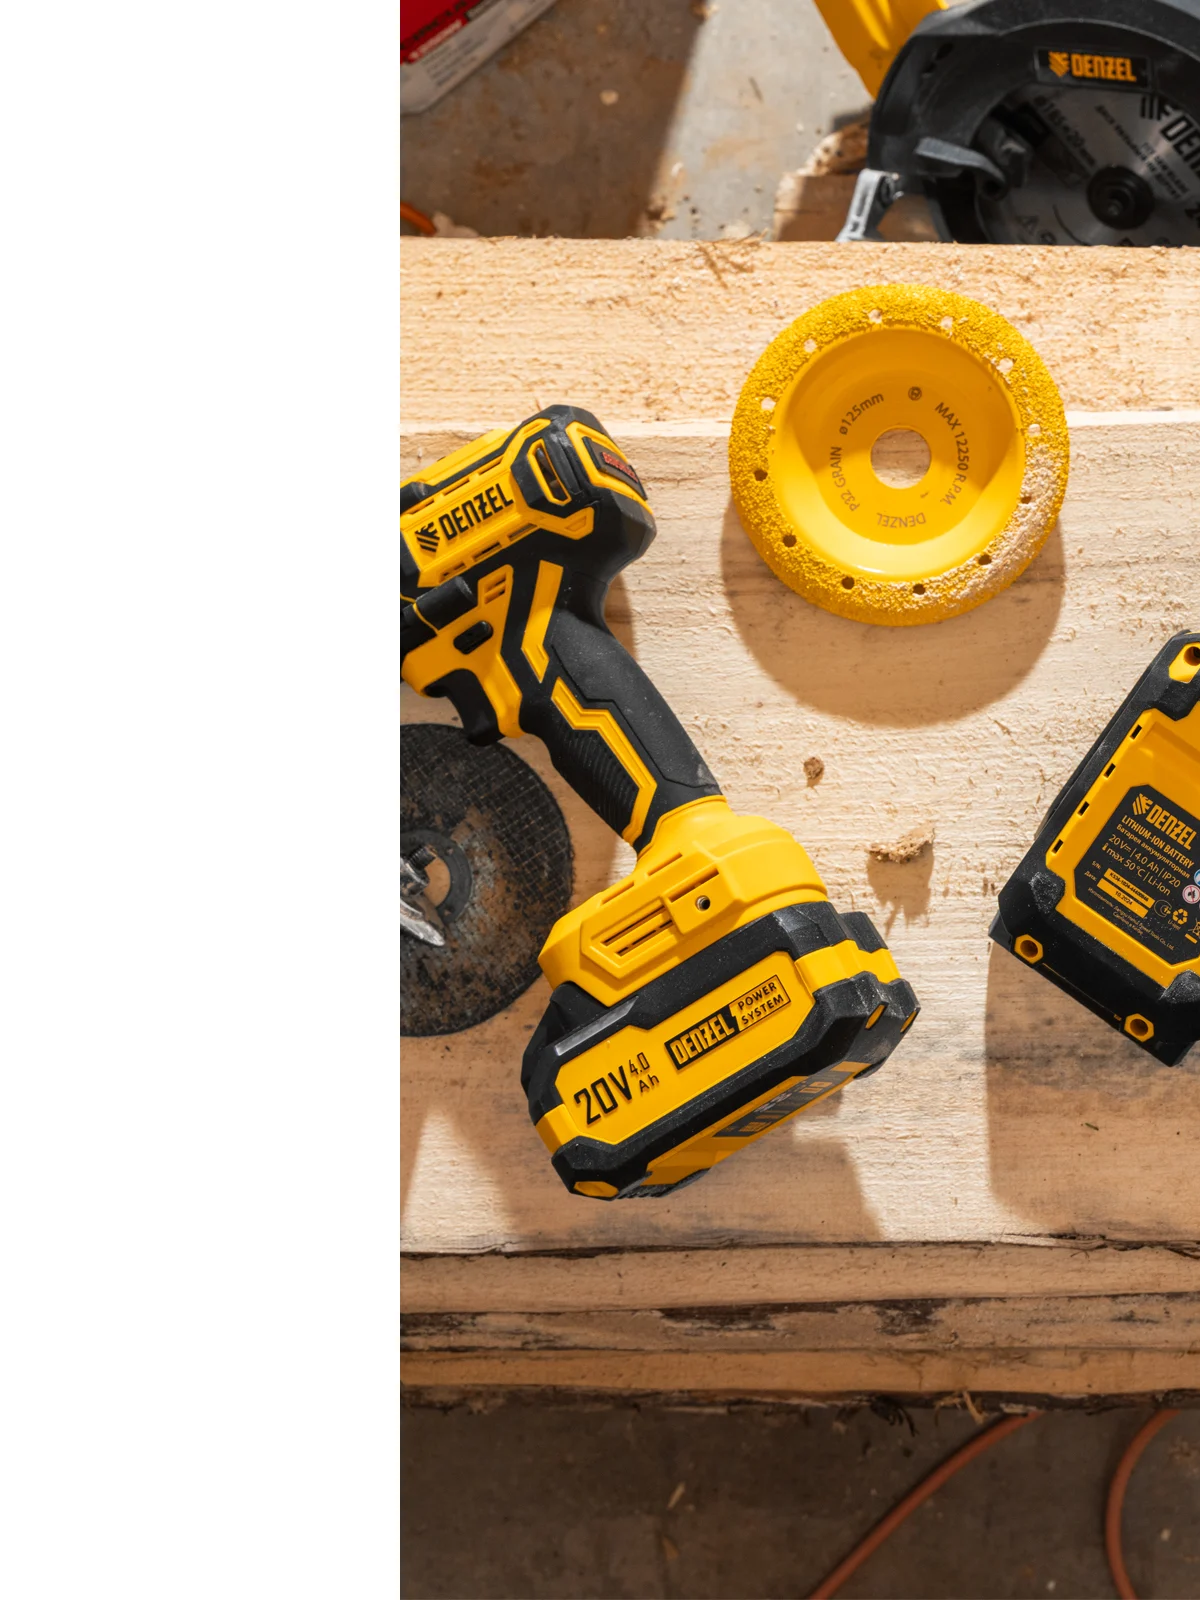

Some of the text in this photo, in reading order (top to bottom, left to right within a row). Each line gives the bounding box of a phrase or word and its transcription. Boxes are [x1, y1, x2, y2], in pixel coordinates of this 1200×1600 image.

[1071, 54, 1136, 81] DENZEL
[934, 402, 961, 430] MAX
[954, 431, 969, 471] 12250
[830, 446, 860, 511] P32 GRAIN
[439, 483, 514, 540] DENZEL
[876, 512, 926, 528] DENZEL
[1115, 823, 1142, 844] Батарея
[1121, 814, 1194, 869] LITHIUM-ION BATTERY
[1145, 803, 1200, 850] DENZEL
[1106, 846, 1125, 863] max
[1133, 851, 1148, 865] 4.0
[1146, 860, 1160, 873] Ah
[1161, 871, 1181, 888] IP20
[669, 982, 777, 1063] DENZEL POWER
[741, 995, 784, 1025] SYSTEM
[573, 1052, 651, 1125] 20V 4.0
[638, 1074, 660, 1092] Ah
